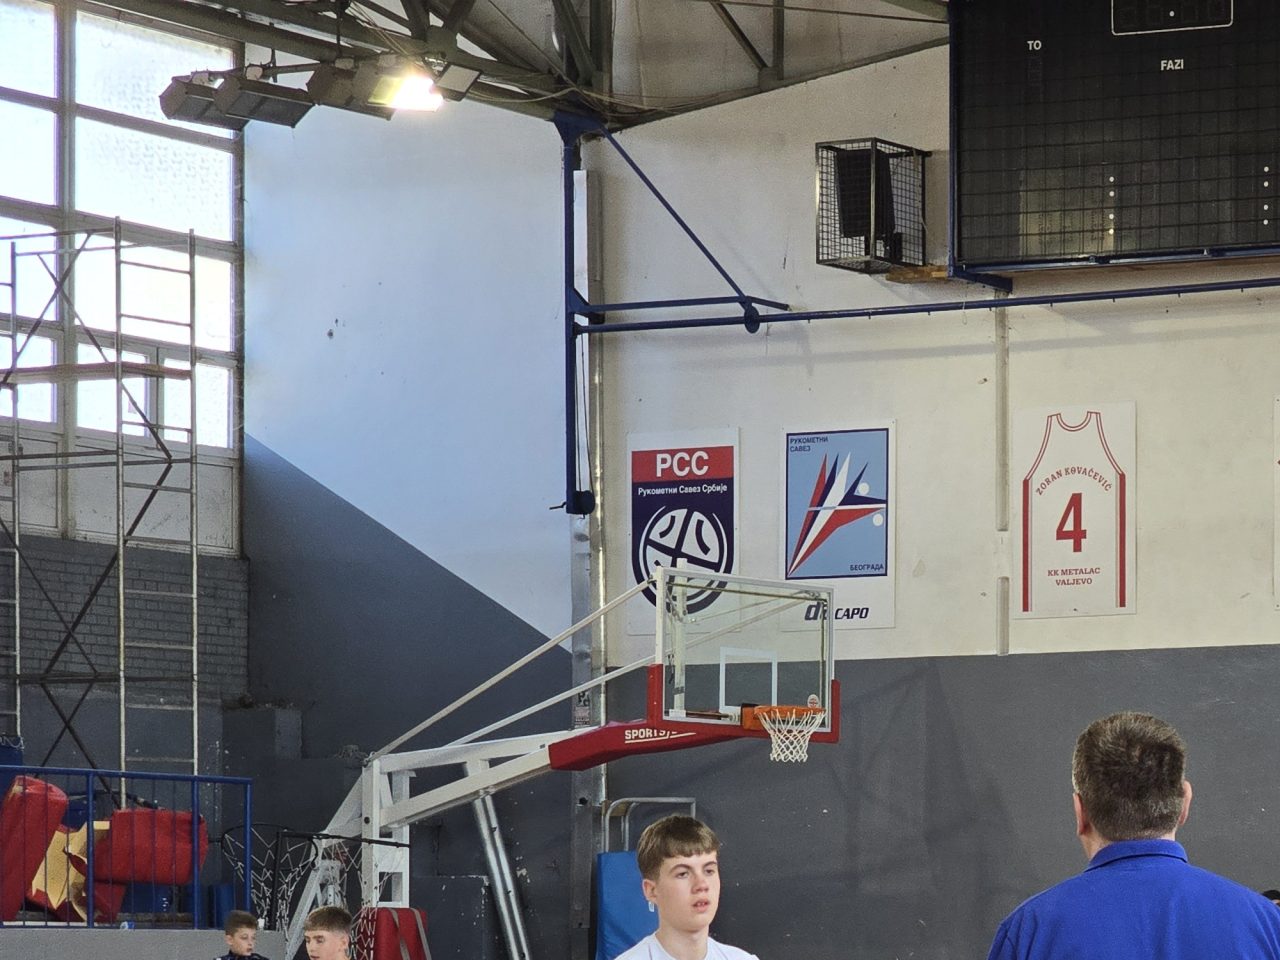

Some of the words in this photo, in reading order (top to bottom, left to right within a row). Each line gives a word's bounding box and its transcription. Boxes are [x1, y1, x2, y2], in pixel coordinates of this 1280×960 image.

[1026, 39, 1042, 51] TO
[1160, 58, 1185, 71] FAZI
[790, 436, 828, 444] РУКОМЕТНИ
[656, 450, 709, 477] РСС
[1036, 469, 1063, 496] ZORAN
[1064, 466, 1112, 492] KOVAČEVIĆ
[638, 485, 677, 496] Рукометни
[679, 484, 701, 494] Савез
[702, 484, 728, 495] Србије
[1056, 492, 1087, 552] 4
[850, 563, 885, 572] БЕОГРАДА
[1048, 569, 1059, 577] KK
[1060, 567, 1100, 576] METALAC
[1055, 578, 1092, 586] VALJEVO
[834, 607, 870, 620] CAPO
